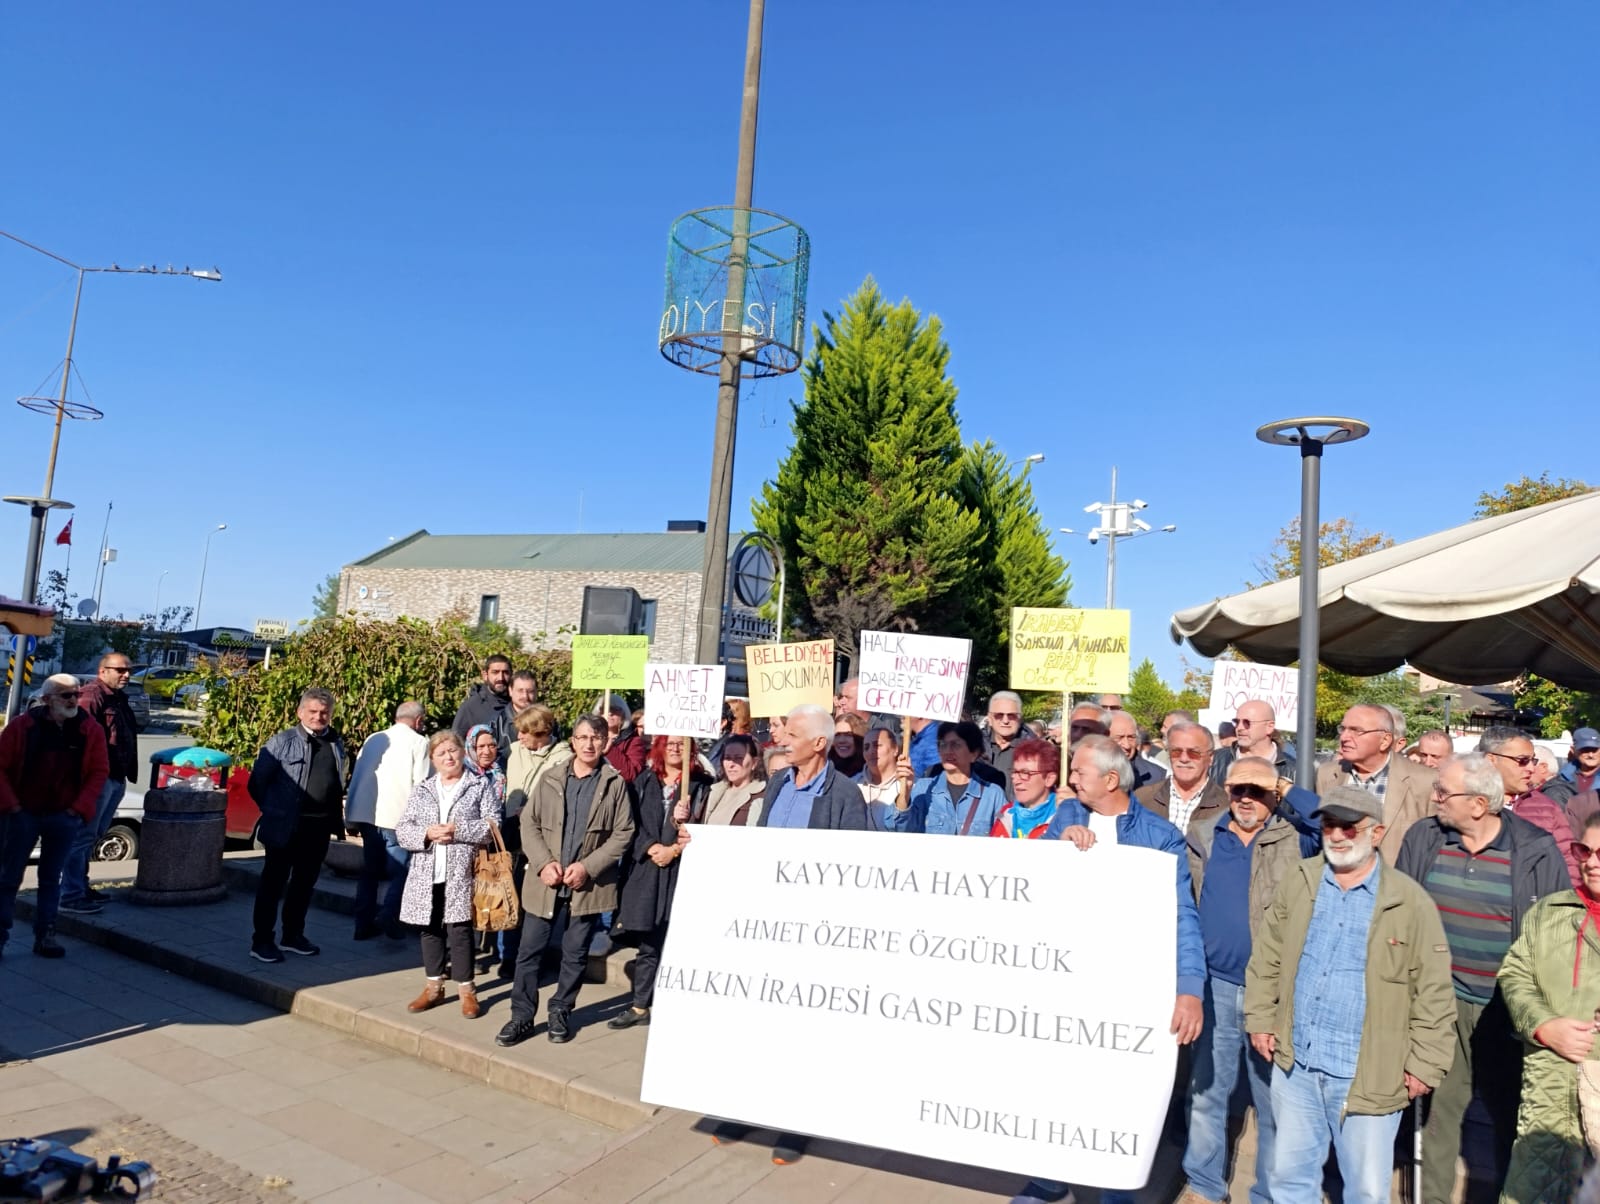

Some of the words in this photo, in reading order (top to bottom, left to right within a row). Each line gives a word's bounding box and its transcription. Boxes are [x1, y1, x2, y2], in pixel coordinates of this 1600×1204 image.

[864, 633, 906, 655] HALK
[649, 668, 714, 693] AHMET
[760, 665, 830, 692] DOKUNMA
[861, 671, 923, 690] DARBEYE
[924, 690, 961, 720] YOK!
[776, 860, 920, 892] KAYYUMA
[930, 870, 1033, 903] HAYIR
[724, 917, 809, 945] AHMET
[814, 920, 902, 954] ÖZER'E
[909, 929, 1073, 973] ÖZGÜRLÜK
[657, 965, 754, 1000] HALKIN
[759, 972, 871, 1017] İRADESİ
[879, 992, 963, 1027] GASP
[972, 1005, 1155, 1055] EDİLEMEZ
[918, 1099, 1038, 1141] FINDIKLI
[1047, 1120, 1139, 1157] HALKI
